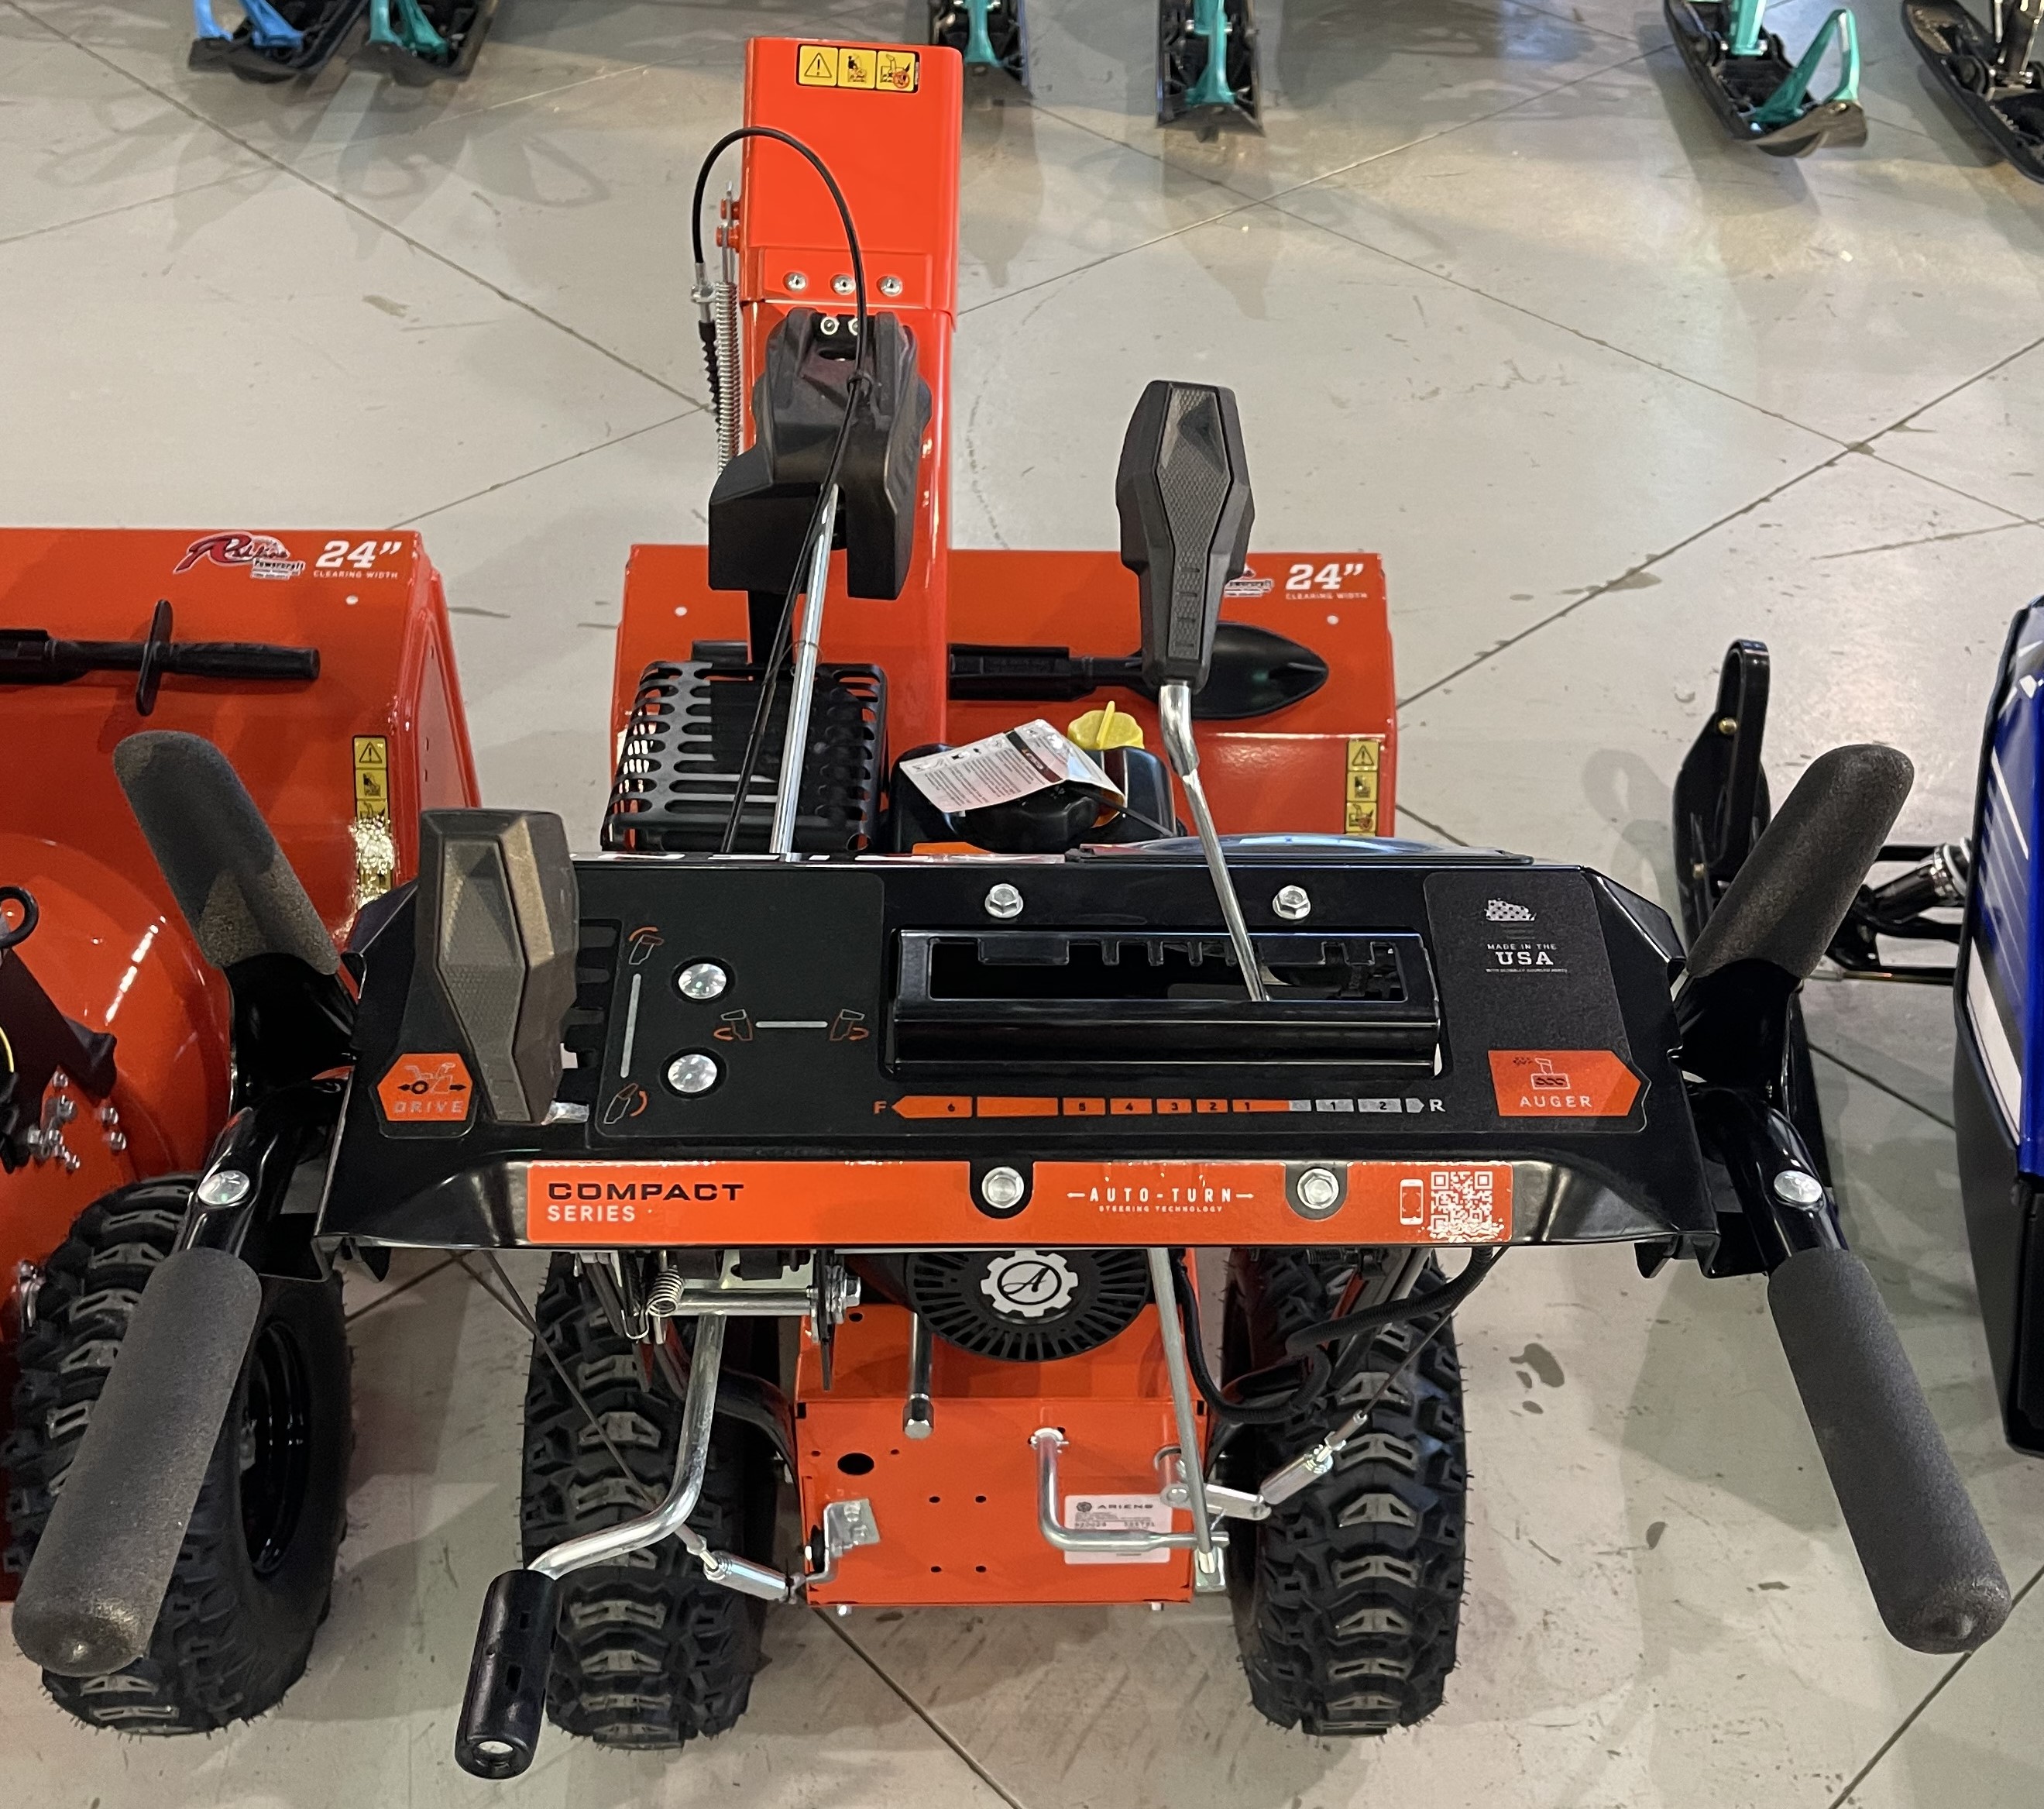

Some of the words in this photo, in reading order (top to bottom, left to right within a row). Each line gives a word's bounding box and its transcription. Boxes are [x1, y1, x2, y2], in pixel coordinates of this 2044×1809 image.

[313, 570, 362, 579] CLEARING
[1496, 951, 1554, 965] USA
[393, 1100, 464, 1114] DRIVE
[873, 1100, 888, 1115] F
[947, 1102, 956, 1113] 6
[1125, 1102, 1135, 1112] 4
[1171, 1102, 1179, 1111] 3
[1209, 1102, 1218, 1111] 2
[1244, 1102, 1250, 1111] 1
[1330, 1101, 1336, 1112] 1
[1379, 1101, 1388, 1112] 2
[1429, 1099, 1446, 1113] R
[1520, 1095, 1592, 1108] AUGER
[548, 1183, 744, 1201] COMPACT
[547, 1205, 635, 1222] SERIES
